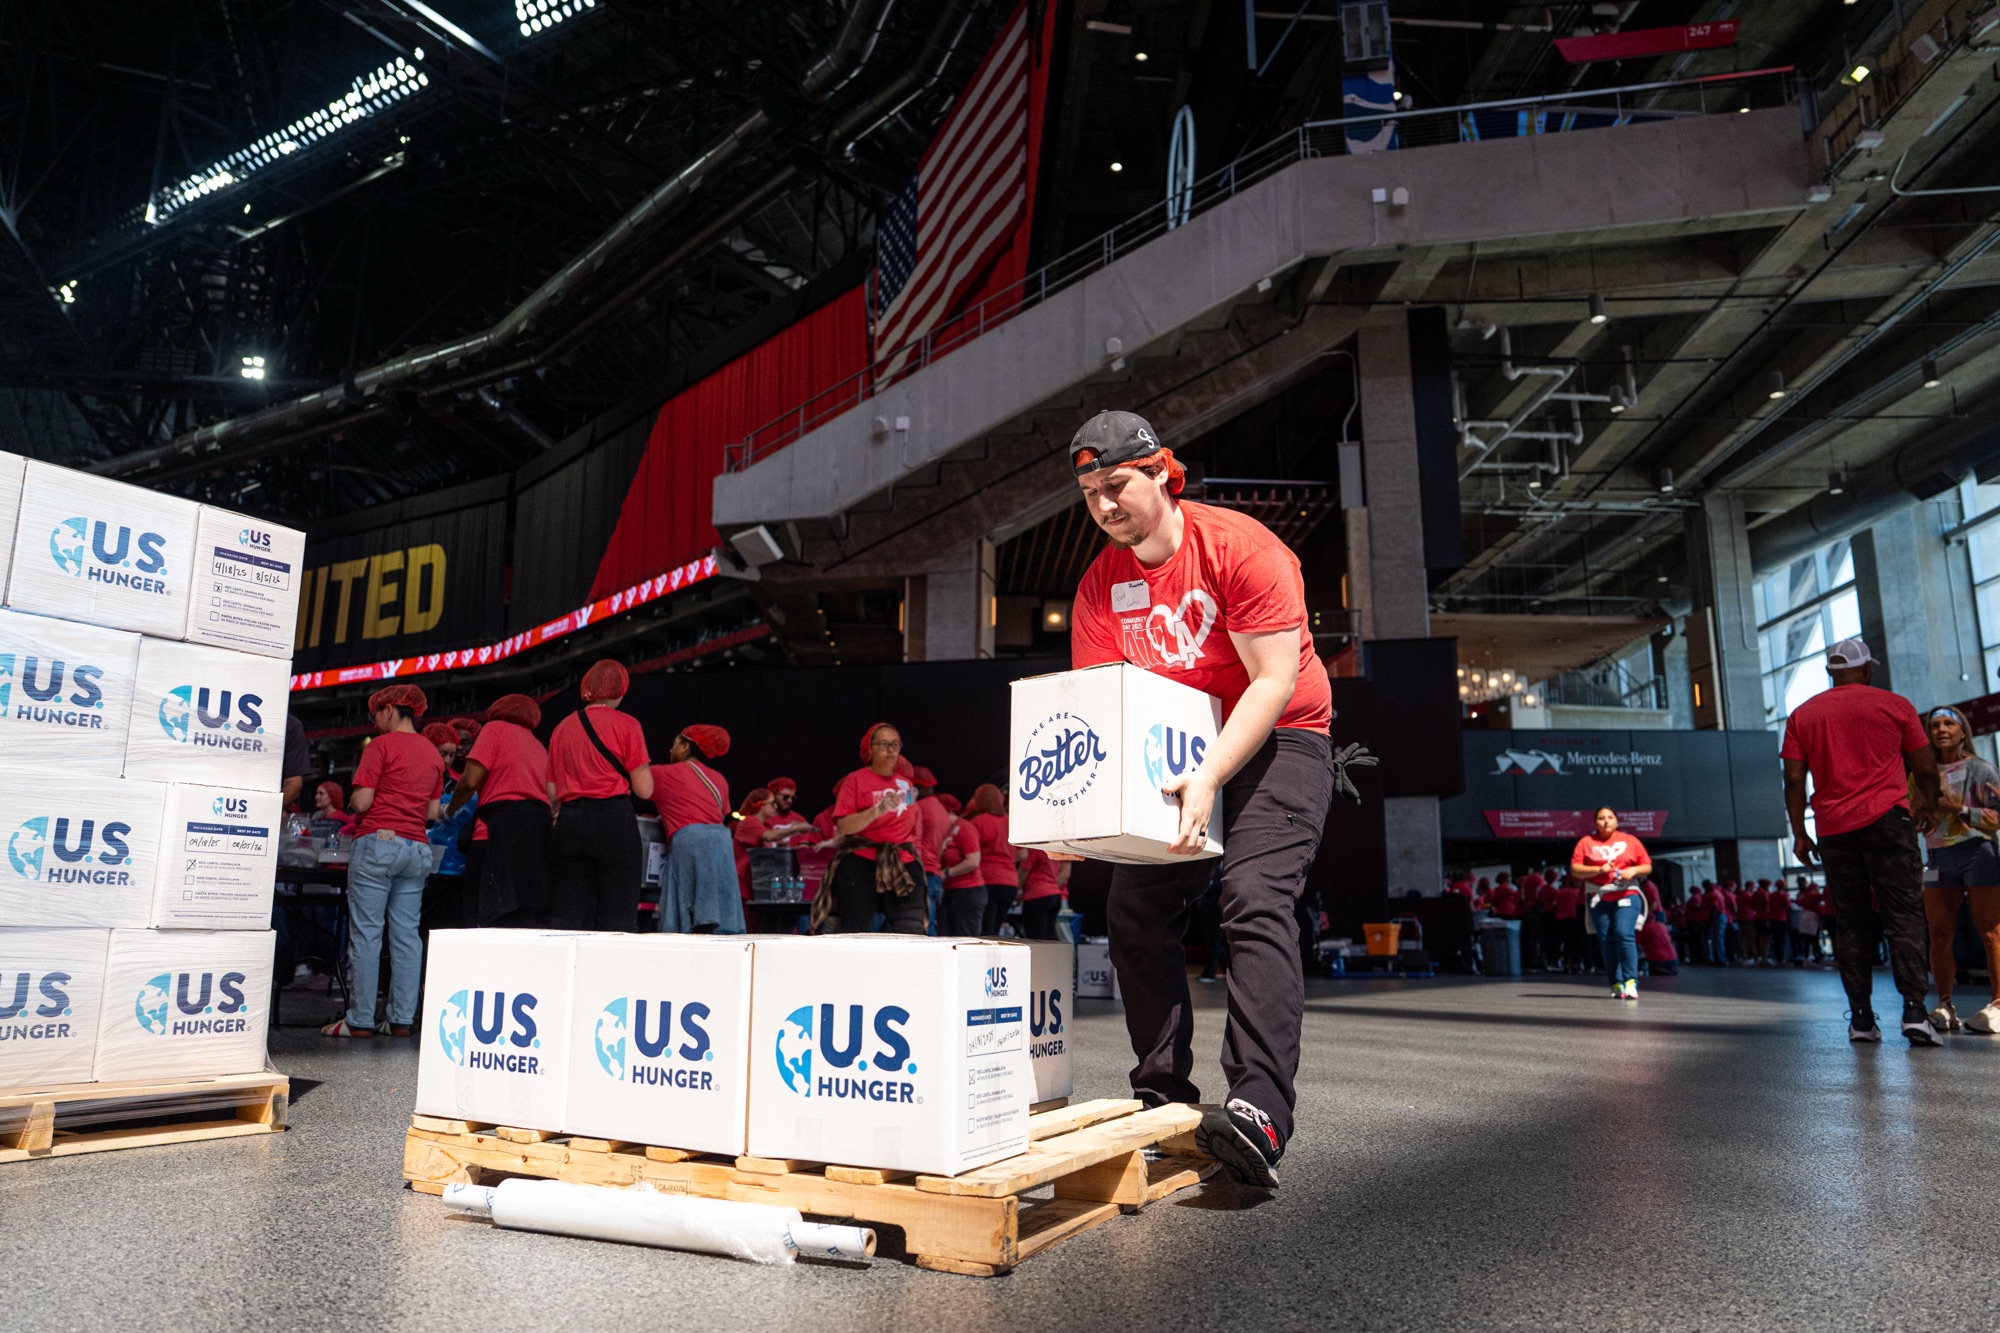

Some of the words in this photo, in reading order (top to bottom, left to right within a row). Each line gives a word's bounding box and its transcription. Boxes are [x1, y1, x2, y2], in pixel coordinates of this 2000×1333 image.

[1689, 25, 1711, 37] 247
[91, 520, 168, 576] U.S.
[215, 562, 247, 577] 4/18/25
[196, 687, 264, 735] U.S.
[1031, 722, 1045, 737] WE
[1048, 712, 1069, 724] ARE
[1019, 728, 1107, 801] Better
[1567, 751, 1662, 765] Mercedes-Benz
[1588, 767, 1643, 775] STADIUM
[1046, 772, 1097, 807] TOGETHER
[53, 817, 132, 866] U.S.
[176, 972, 247, 1015] U.S.
[1030, 989, 1064, 1037] U.S.
[0, 1023, 71, 1041] UNGER
[472, 990, 540, 1048] U.S.
[634, 999, 714, 1062] U.S.
[819, 1003, 918, 1075] U.S.
